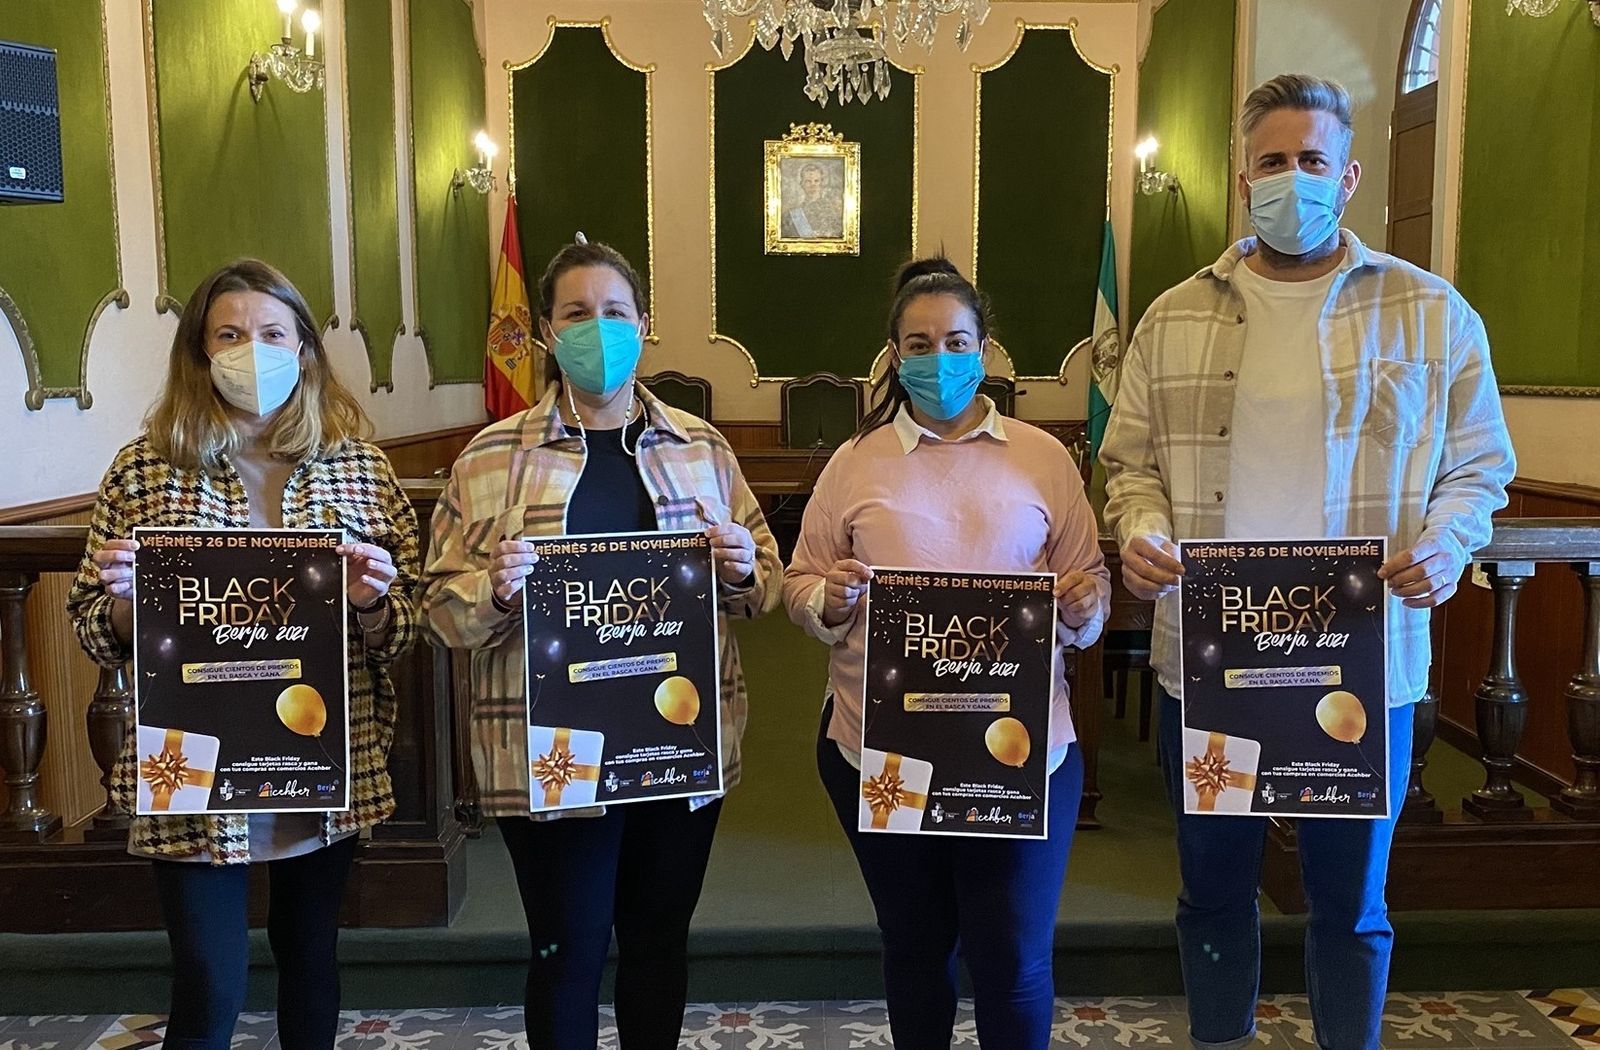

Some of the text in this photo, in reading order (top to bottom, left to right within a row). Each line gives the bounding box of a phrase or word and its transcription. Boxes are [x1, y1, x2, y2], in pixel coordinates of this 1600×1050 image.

[141, 537, 337, 548] VIERNES 26 DE NOVIEMBRE
[590, 542, 605, 553] 26
[609, 541, 627, 552] DE
[631, 537, 707, 551] NOVIEMBRE
[1187, 545, 1378, 558] VIERNES 26 DE NOVIEMBRE
[179, 577, 296, 602] BLACK
[565, 576, 671, 606] BLACK
[875, 575, 1050, 591] VIERNES 26 DE NOVIEMBRE
[1222, 585, 1336, 610] BLACK
[179, 603, 296, 625] FRIDAY
[566, 600, 671, 628] FRIDAY
[1222, 611, 1336, 632] FRIDAY
[212, 623, 309, 649] Berja 2021
[596, 620, 683, 646] Berja 2021
[905, 613, 1010, 640] BLACK
[904, 637, 1009, 662] FRIDAY
[1254, 630, 1350, 656] Berja 2021
[574, 665, 605, 674] CONSIGUE
[608, 661, 635, 670] CIENTOS
[647, 657, 674, 665] PREMIOS
[612, 668, 633, 676] RASCA
[640, 665, 658, 673] GANA
[933, 658, 1020, 682] Berja 2021
